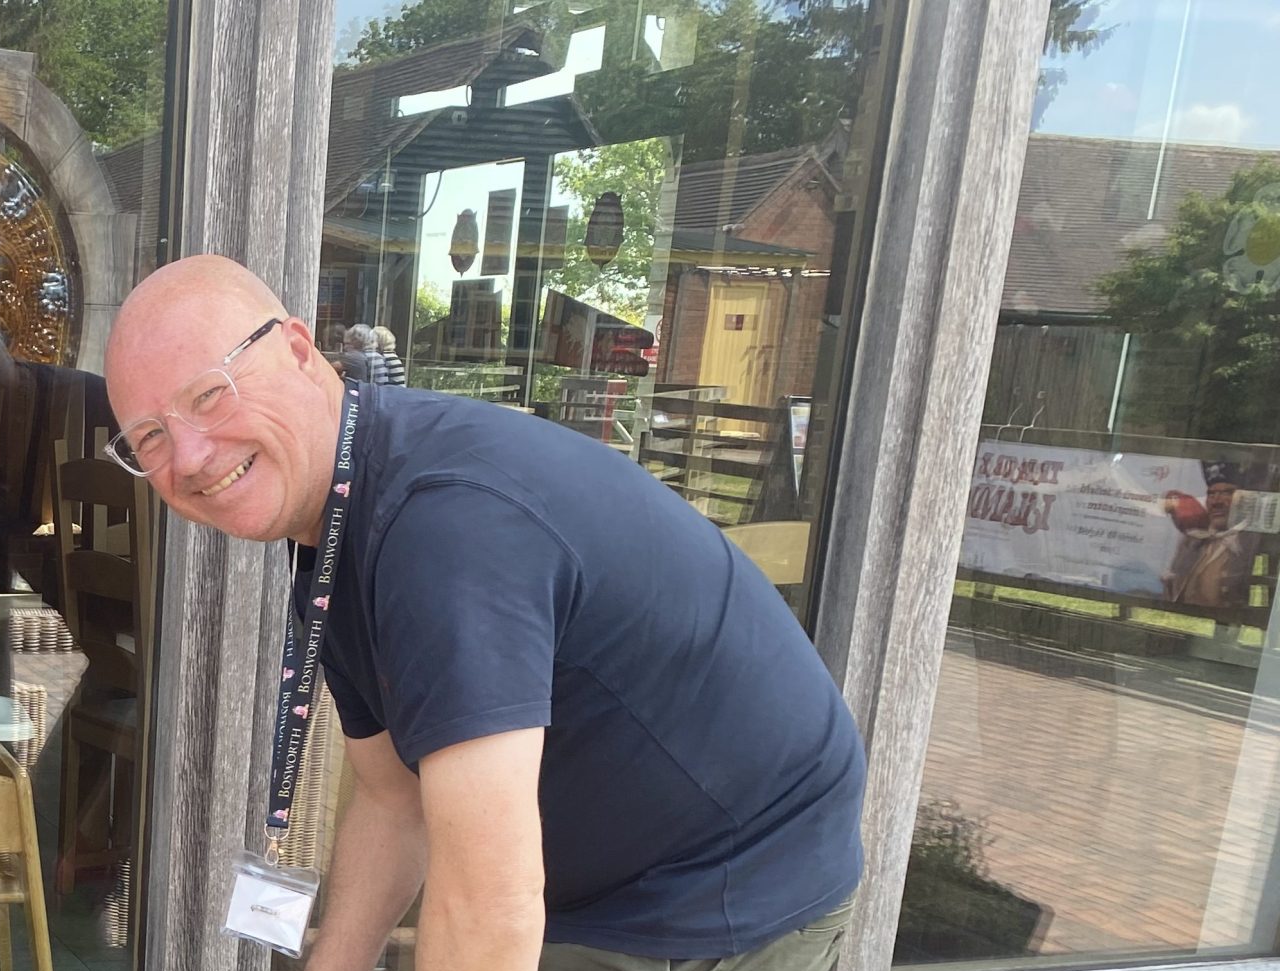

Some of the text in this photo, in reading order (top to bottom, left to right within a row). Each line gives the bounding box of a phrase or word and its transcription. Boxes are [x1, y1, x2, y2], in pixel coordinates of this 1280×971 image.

[337, 403, 359, 470] BOSWORTH
[318, 507, 344, 584] BOSWORTH
[297, 620, 322, 693] BOSWORTH
[278, 727, 302, 798] BOSWORTH
